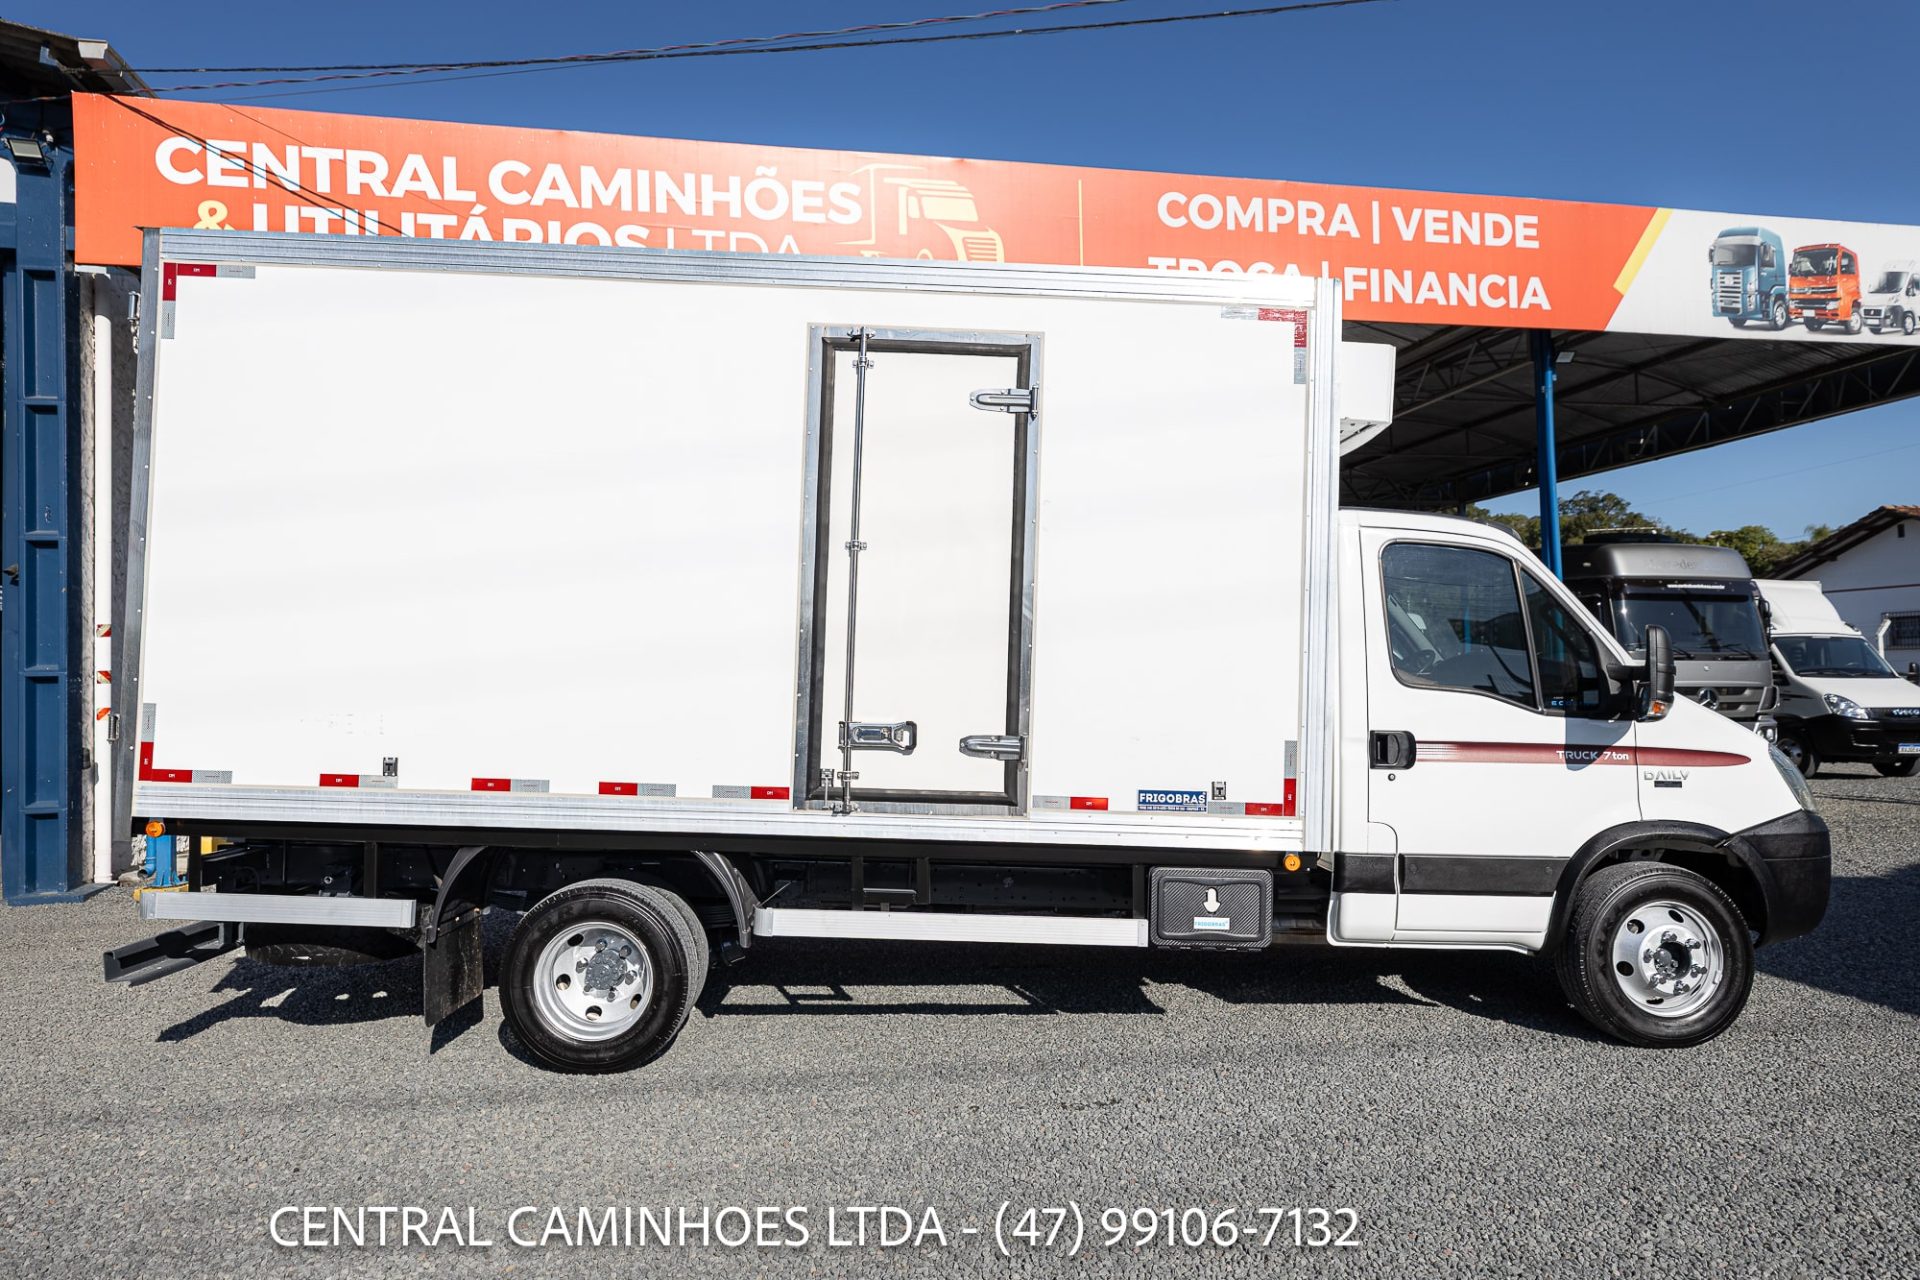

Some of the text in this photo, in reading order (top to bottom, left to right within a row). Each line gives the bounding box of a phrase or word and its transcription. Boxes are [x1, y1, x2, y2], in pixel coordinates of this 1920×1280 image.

[155, 136, 863, 225] CENTRAL CAMINHÕES
[1157, 191, 1361, 238] COMPRA
[1392, 206, 1540, 249] VENDE
[1343, 265, 1552, 310] FINANCIA
[1556, 750, 1598, 760] TRUCK
[1643, 769, 1690, 781] DAILY
[1139, 792, 1206, 804] FRIGOBRAS
